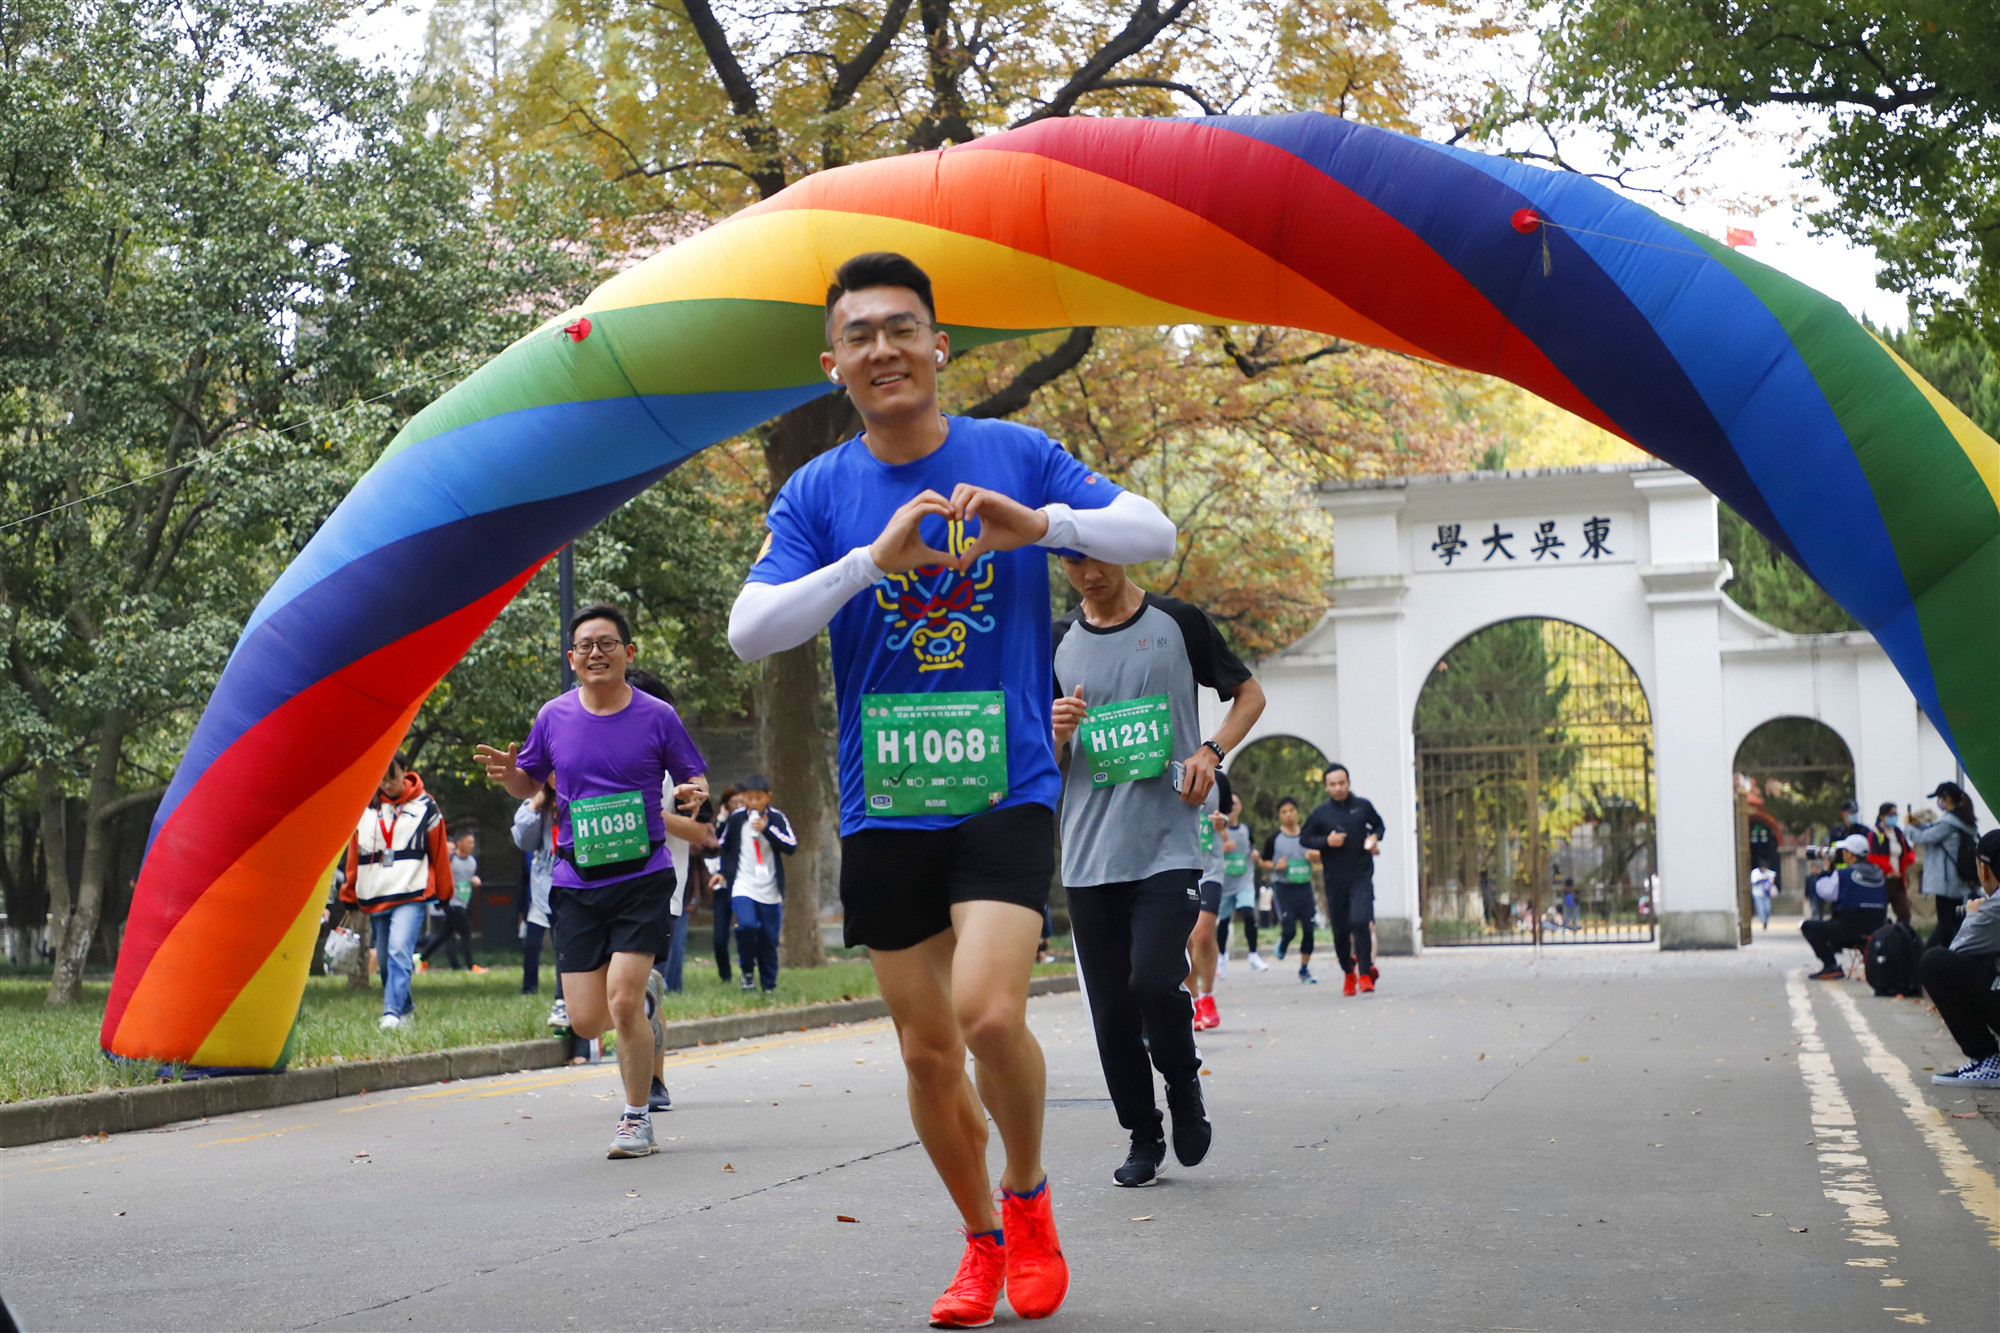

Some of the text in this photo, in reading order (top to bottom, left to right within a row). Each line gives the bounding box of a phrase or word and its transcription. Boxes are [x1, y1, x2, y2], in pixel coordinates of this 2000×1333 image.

[876, 728, 986, 764] H1068
[1090, 719, 1160, 753] H1221
[576, 812, 637, 838] H1038
